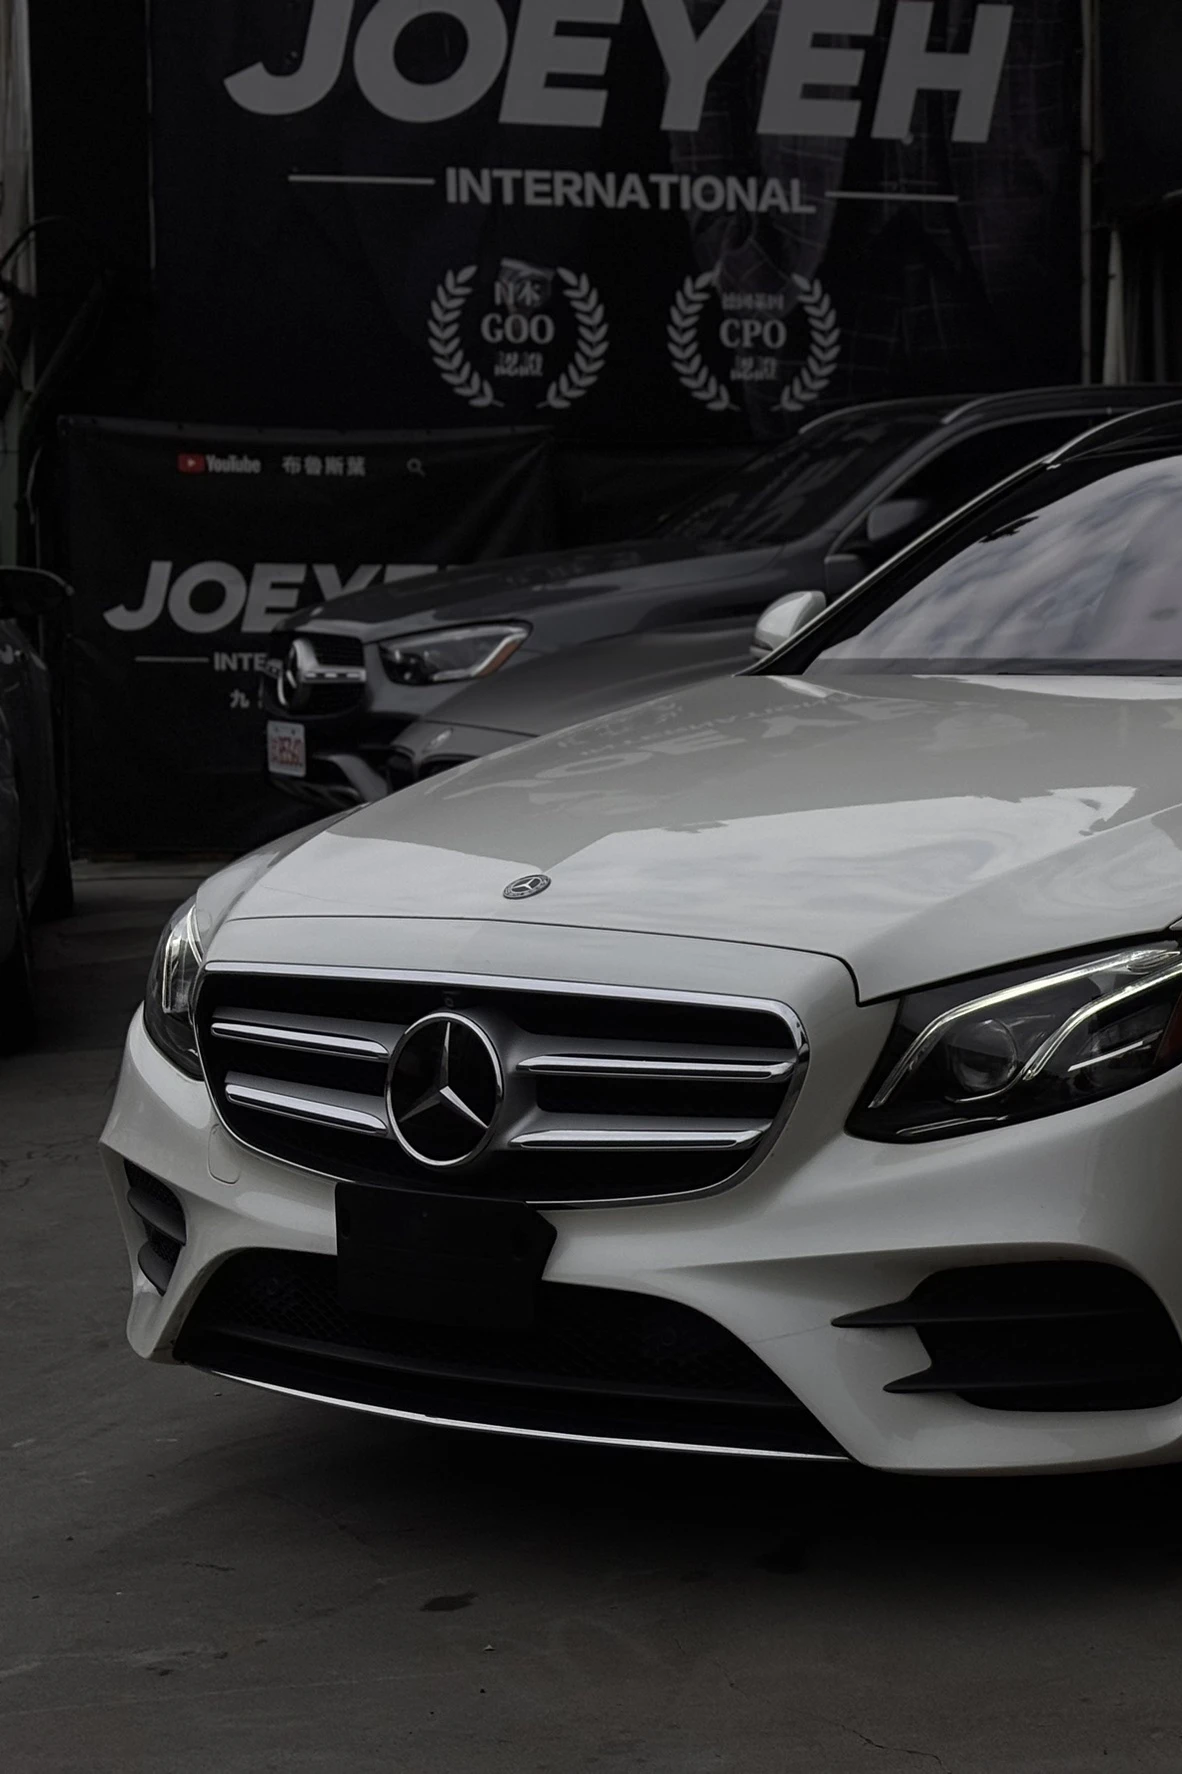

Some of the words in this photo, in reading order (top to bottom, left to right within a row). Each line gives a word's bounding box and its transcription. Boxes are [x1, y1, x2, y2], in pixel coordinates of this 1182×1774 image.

[223, 0, 1013, 143] JOEYEH
[444, 166, 818, 214] INTERNATIONAL
[480, 312, 556, 345] GOO
[718, 317, 788, 350] CPO
[205, 453, 263, 475] YouTube
